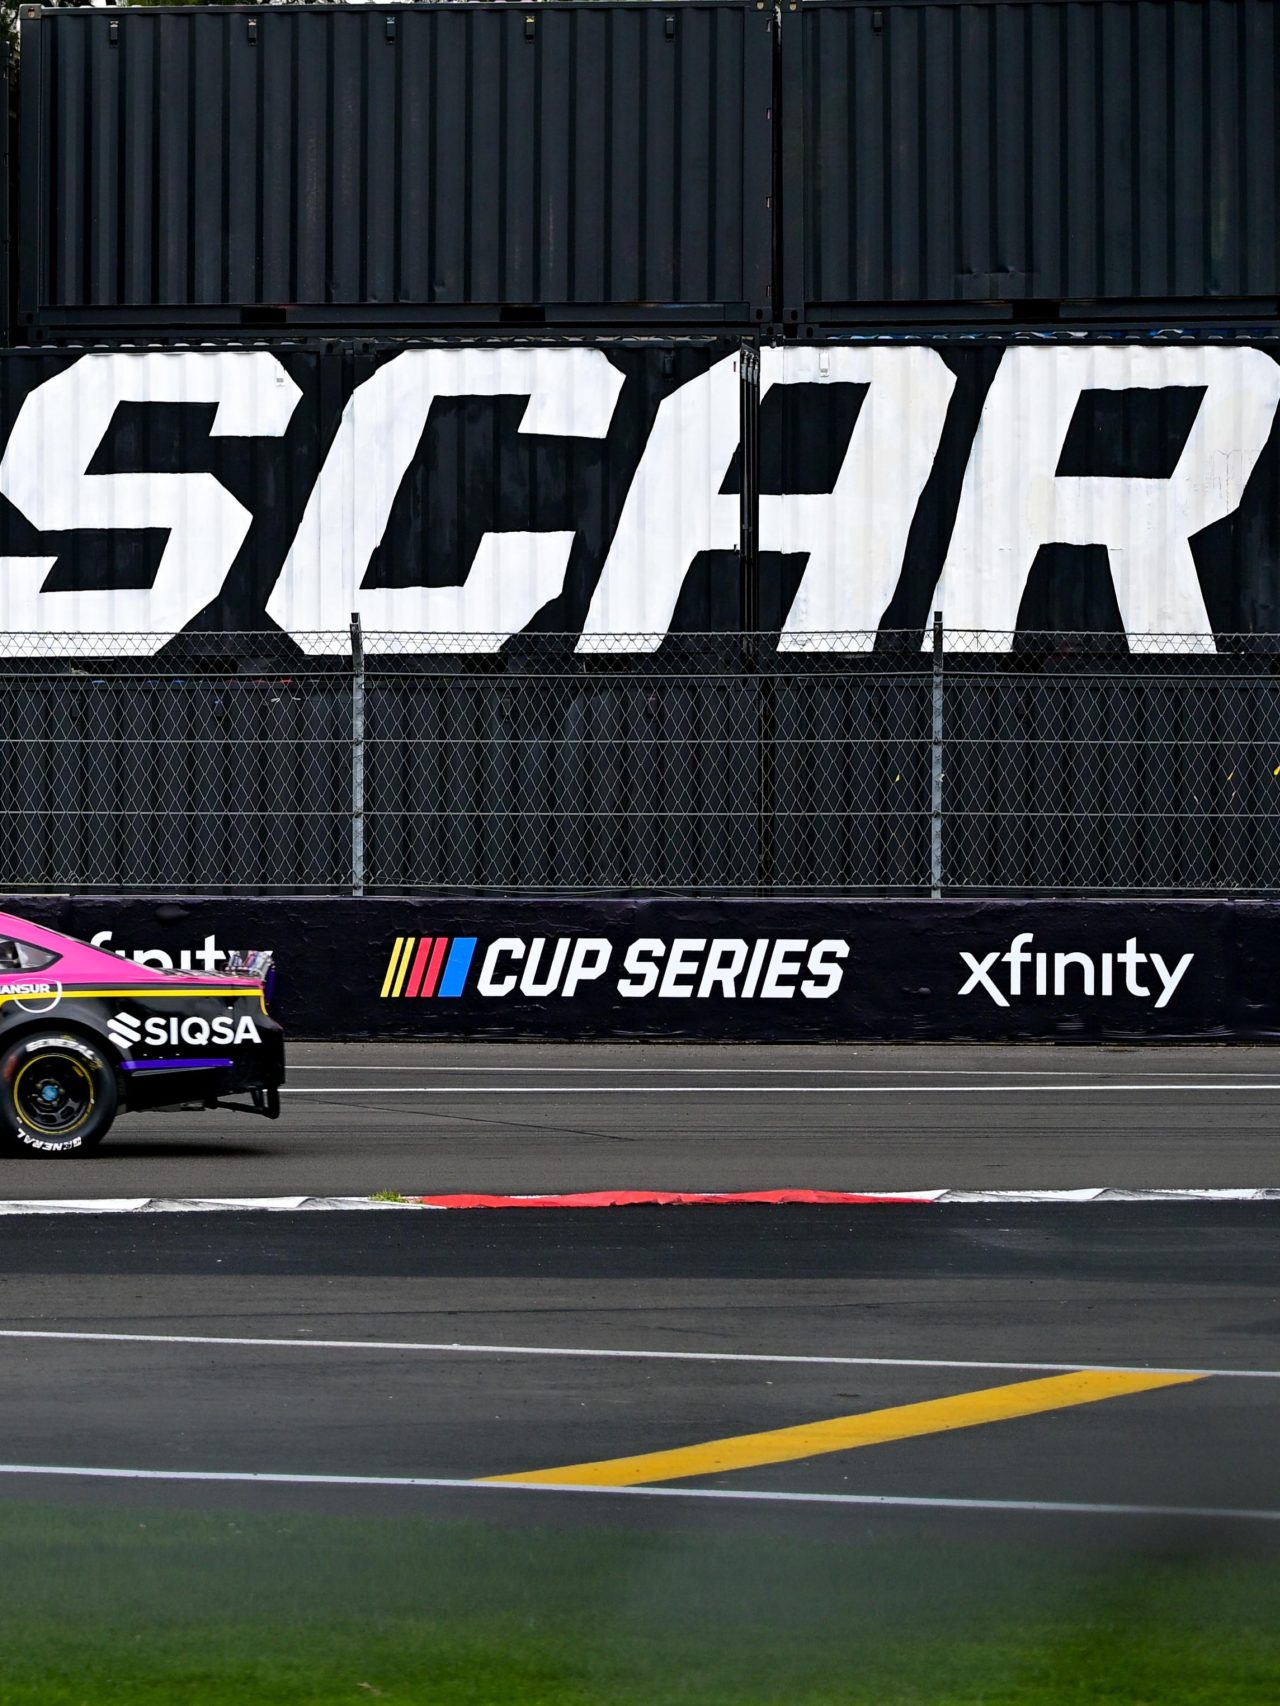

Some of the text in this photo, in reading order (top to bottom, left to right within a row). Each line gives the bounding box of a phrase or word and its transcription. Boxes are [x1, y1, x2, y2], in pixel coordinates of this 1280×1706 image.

[477, 937, 851, 999] CUP SERIES
[957, 932, 1195, 1008] xfinity
[144, 1015, 262, 1046] SIQSA
[16, 1127, 82, 1152] GENERAL
